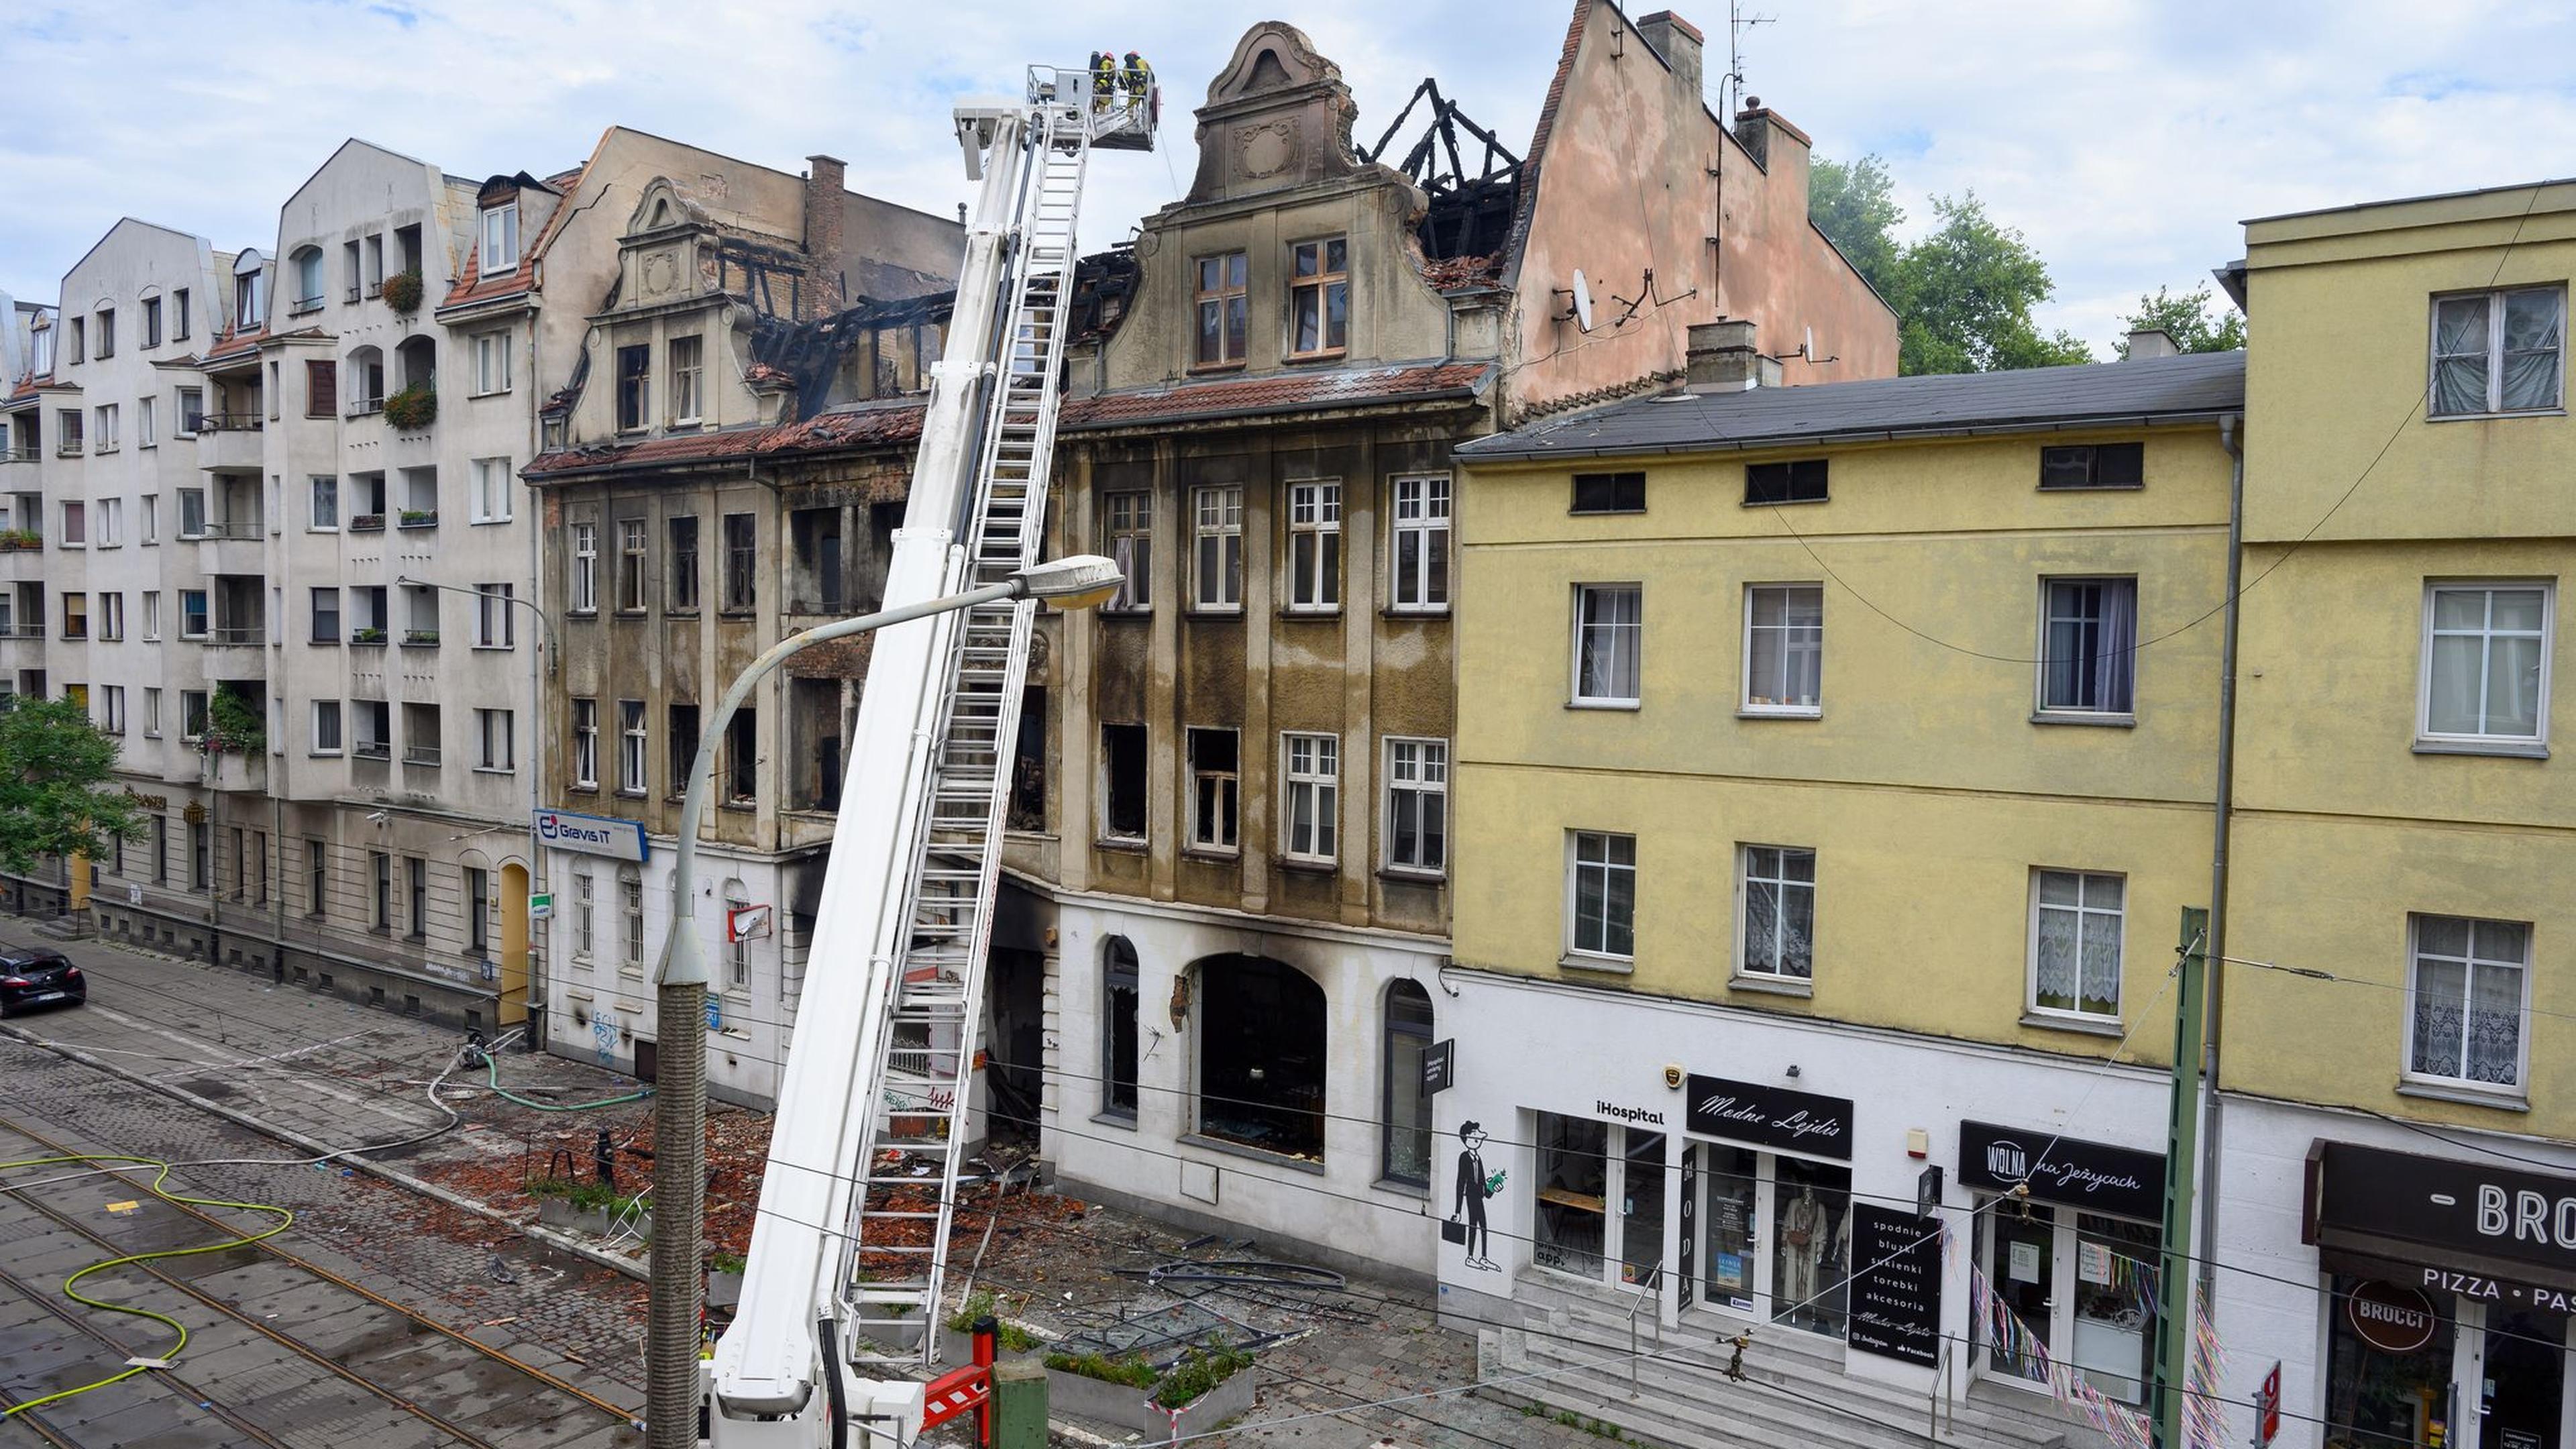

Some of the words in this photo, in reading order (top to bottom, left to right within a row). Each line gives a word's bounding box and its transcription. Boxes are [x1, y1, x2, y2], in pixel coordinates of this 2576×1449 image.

[560, 824, 598, 842] Gravis
[1597, 1101, 1664, 1125] iHospital
[1698, 1095, 1766, 1124] Modne
[1772, 1110, 1841, 1138] Lejdis
[1987, 1145, 2026, 1178] WOLNA
[2033, 1161, 2061, 1175] na
[1874, 1222, 1922, 1238] spodnie
[1878, 1239, 1915, 1254] bluzki
[1871, 1257, 1921, 1275] sukienki
[1874, 1275, 1918, 1293] torebki
[2424, 1268, 2500, 1299] PIZZA
[1866, 1292, 1924, 1312] akcesoria
